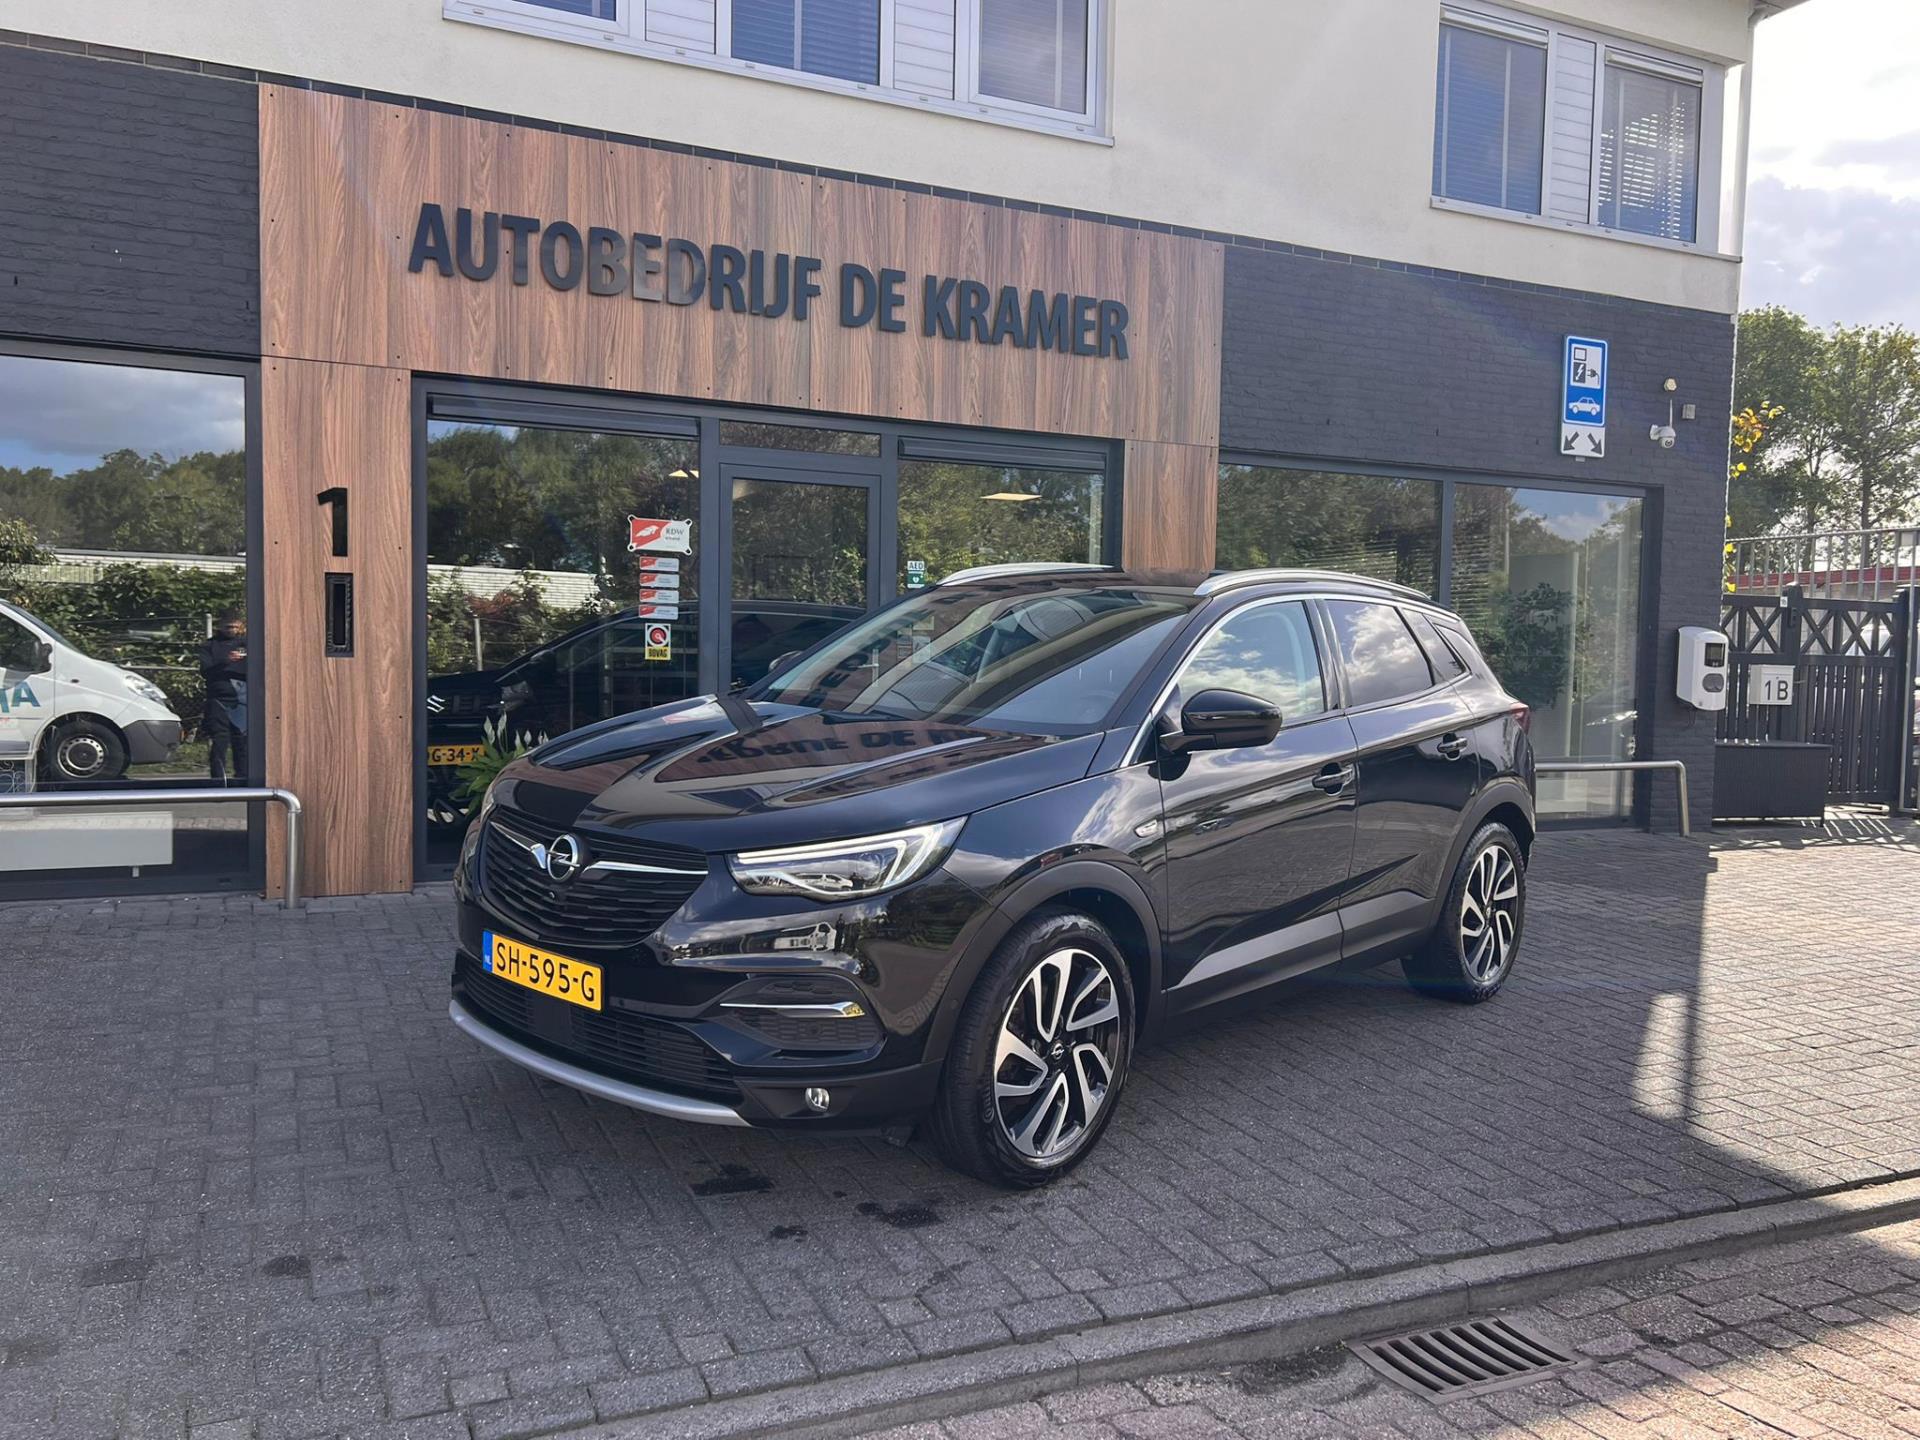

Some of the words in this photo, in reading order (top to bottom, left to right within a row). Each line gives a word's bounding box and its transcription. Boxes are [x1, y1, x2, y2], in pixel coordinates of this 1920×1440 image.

[408, 203, 821, 321] AUTOBEDRIJF
[840, 264, 906, 333] DE
[922, 273, 1129, 360] KRAMER
[317, 487, 348, 557] 1
[496, 942, 595, 1002] SH-595-G
